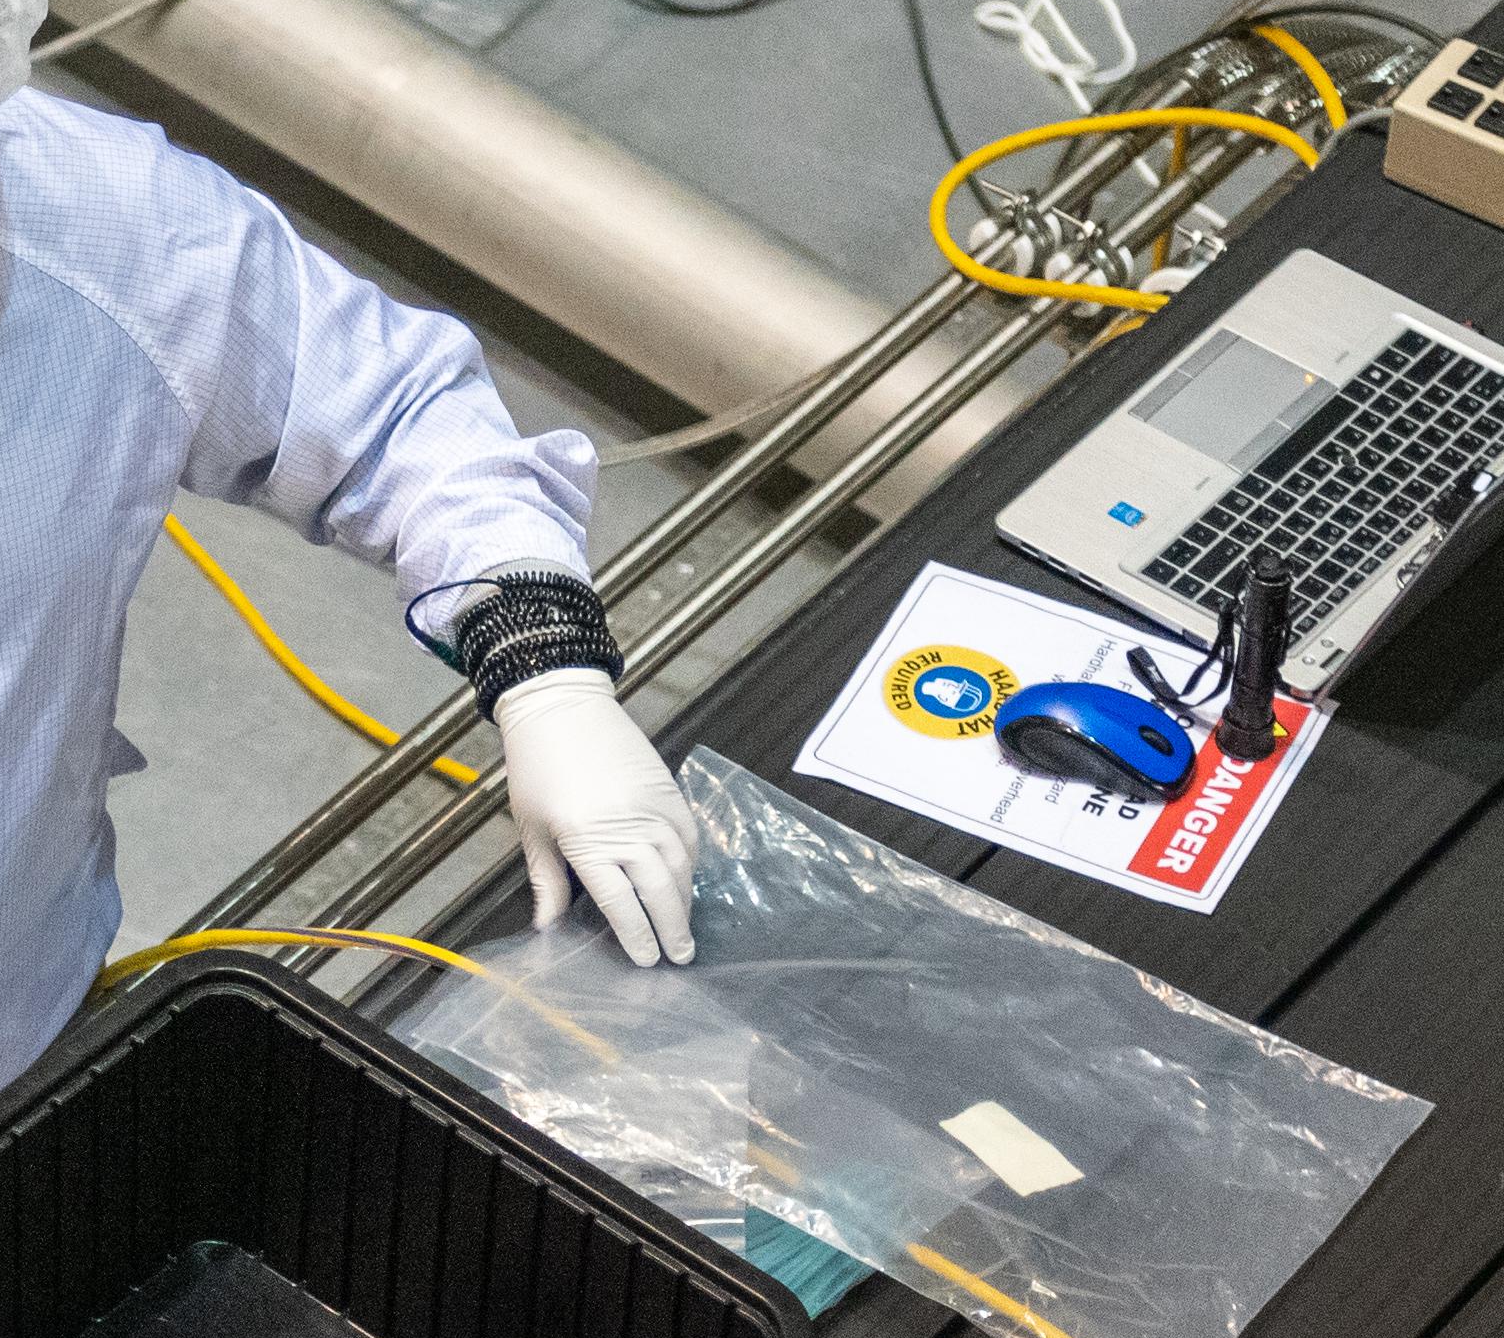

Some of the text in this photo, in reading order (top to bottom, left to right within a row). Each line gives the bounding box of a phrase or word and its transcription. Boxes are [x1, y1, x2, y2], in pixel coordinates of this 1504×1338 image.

[891, 651, 943, 711] REQUIRED
[1079, 639, 1118, 683] Hardha
[957, 714, 995, 736] HAT
[1156, 755, 1254, 875] DANGER
